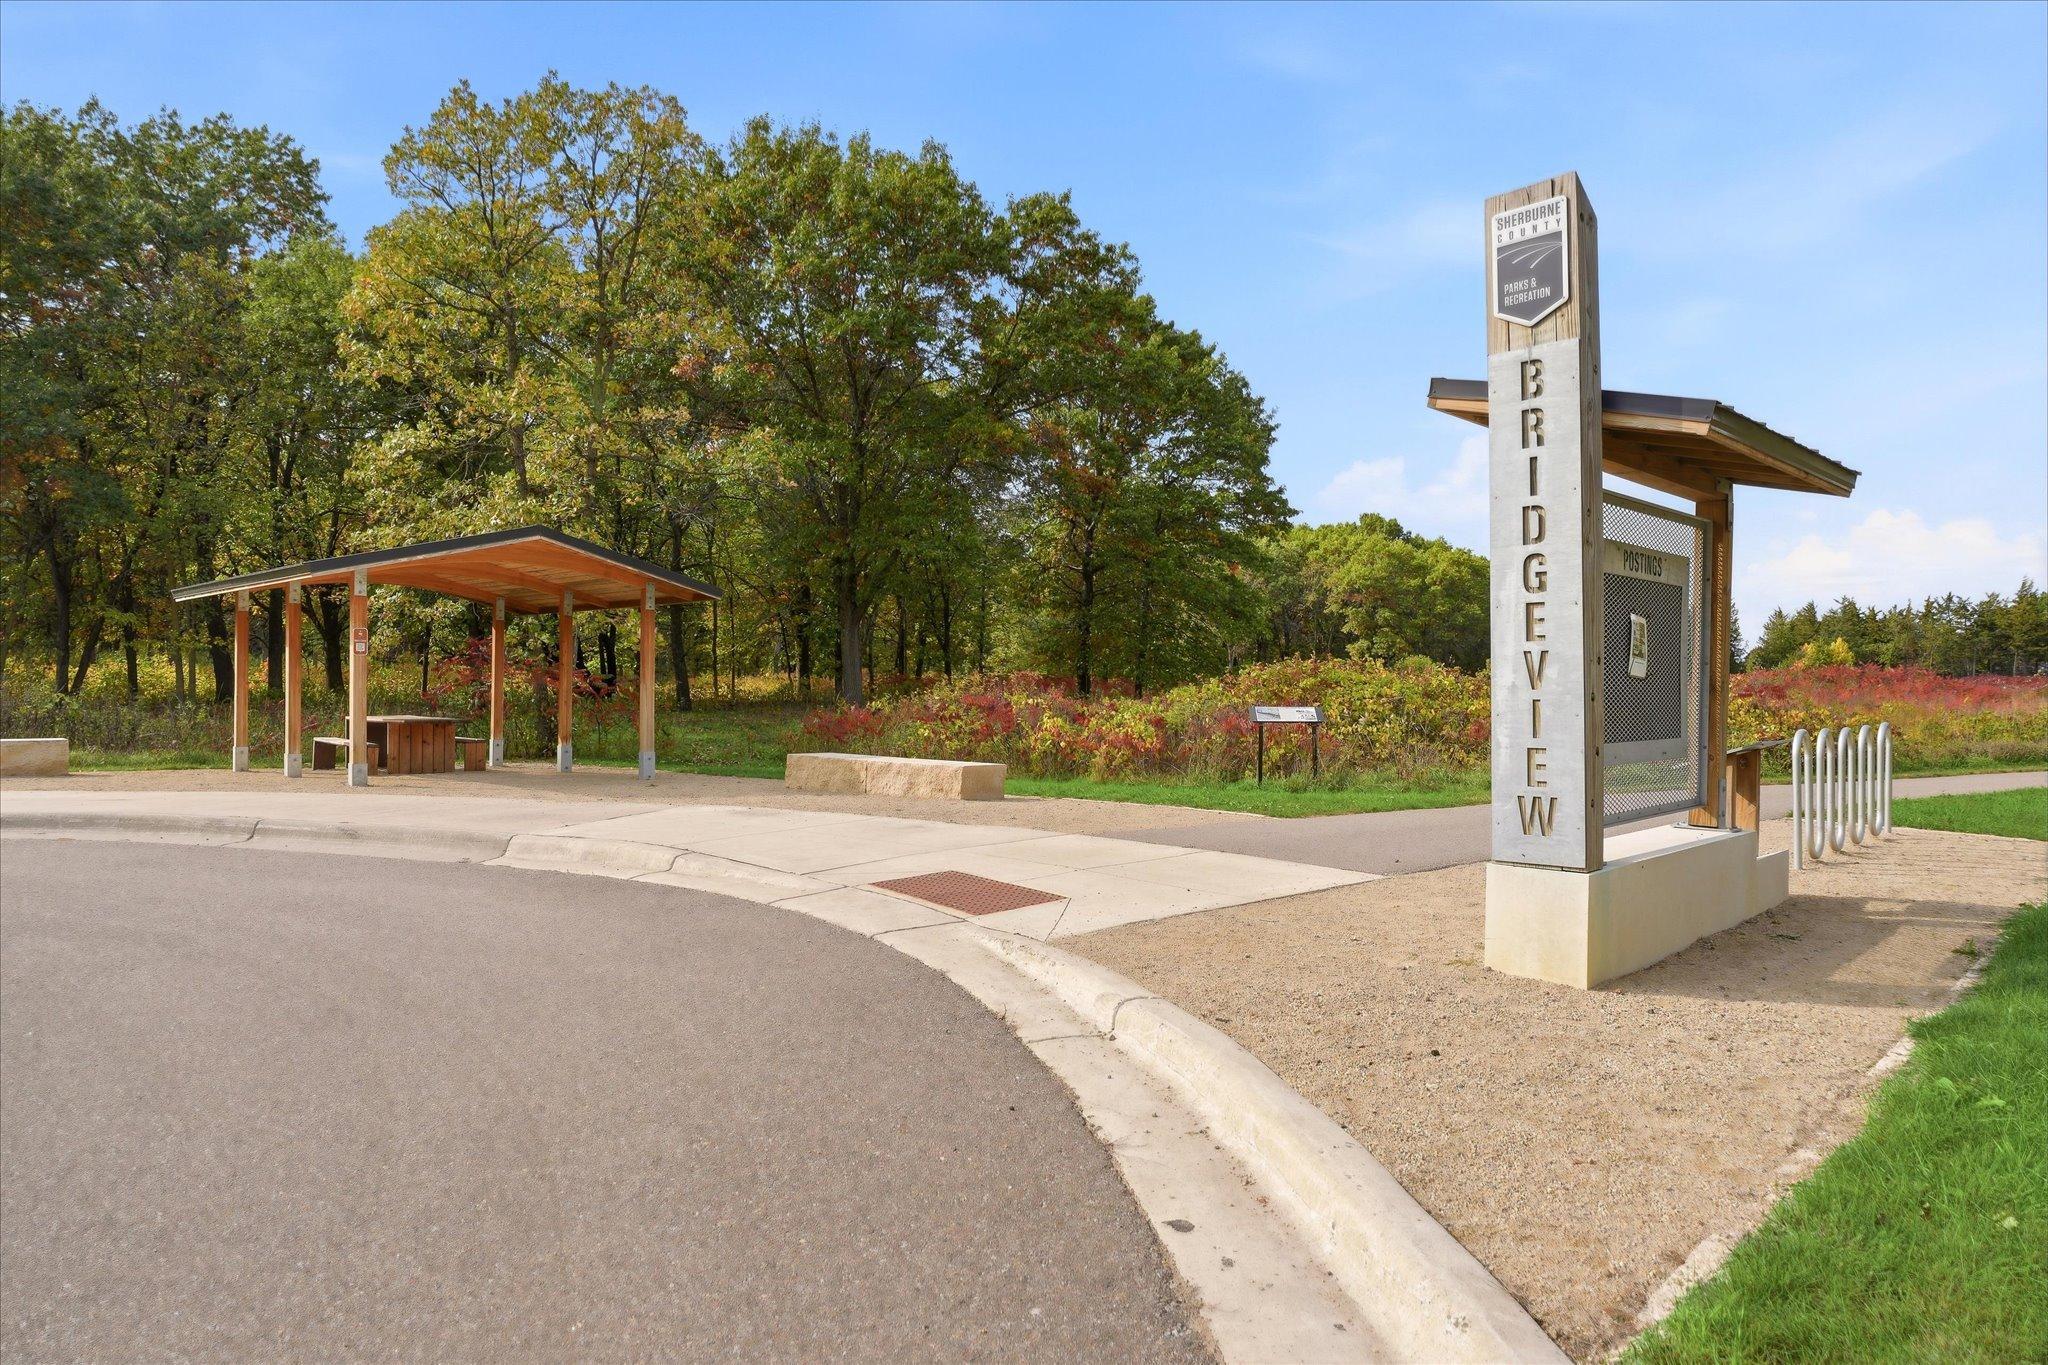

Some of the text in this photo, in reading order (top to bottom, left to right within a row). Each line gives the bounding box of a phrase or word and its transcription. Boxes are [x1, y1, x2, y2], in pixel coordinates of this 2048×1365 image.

[1497, 201, 1561, 231] SHERBURNE
[1497, 218, 1561, 244] COUNTY
[1504, 277, 1537, 295] PARKS &
[1504, 286, 1551, 307] RECREATION
[1623, 549, 1663, 577] POSTINGS
[1517, 358, 1557, 837] BRIDGEVIEW
